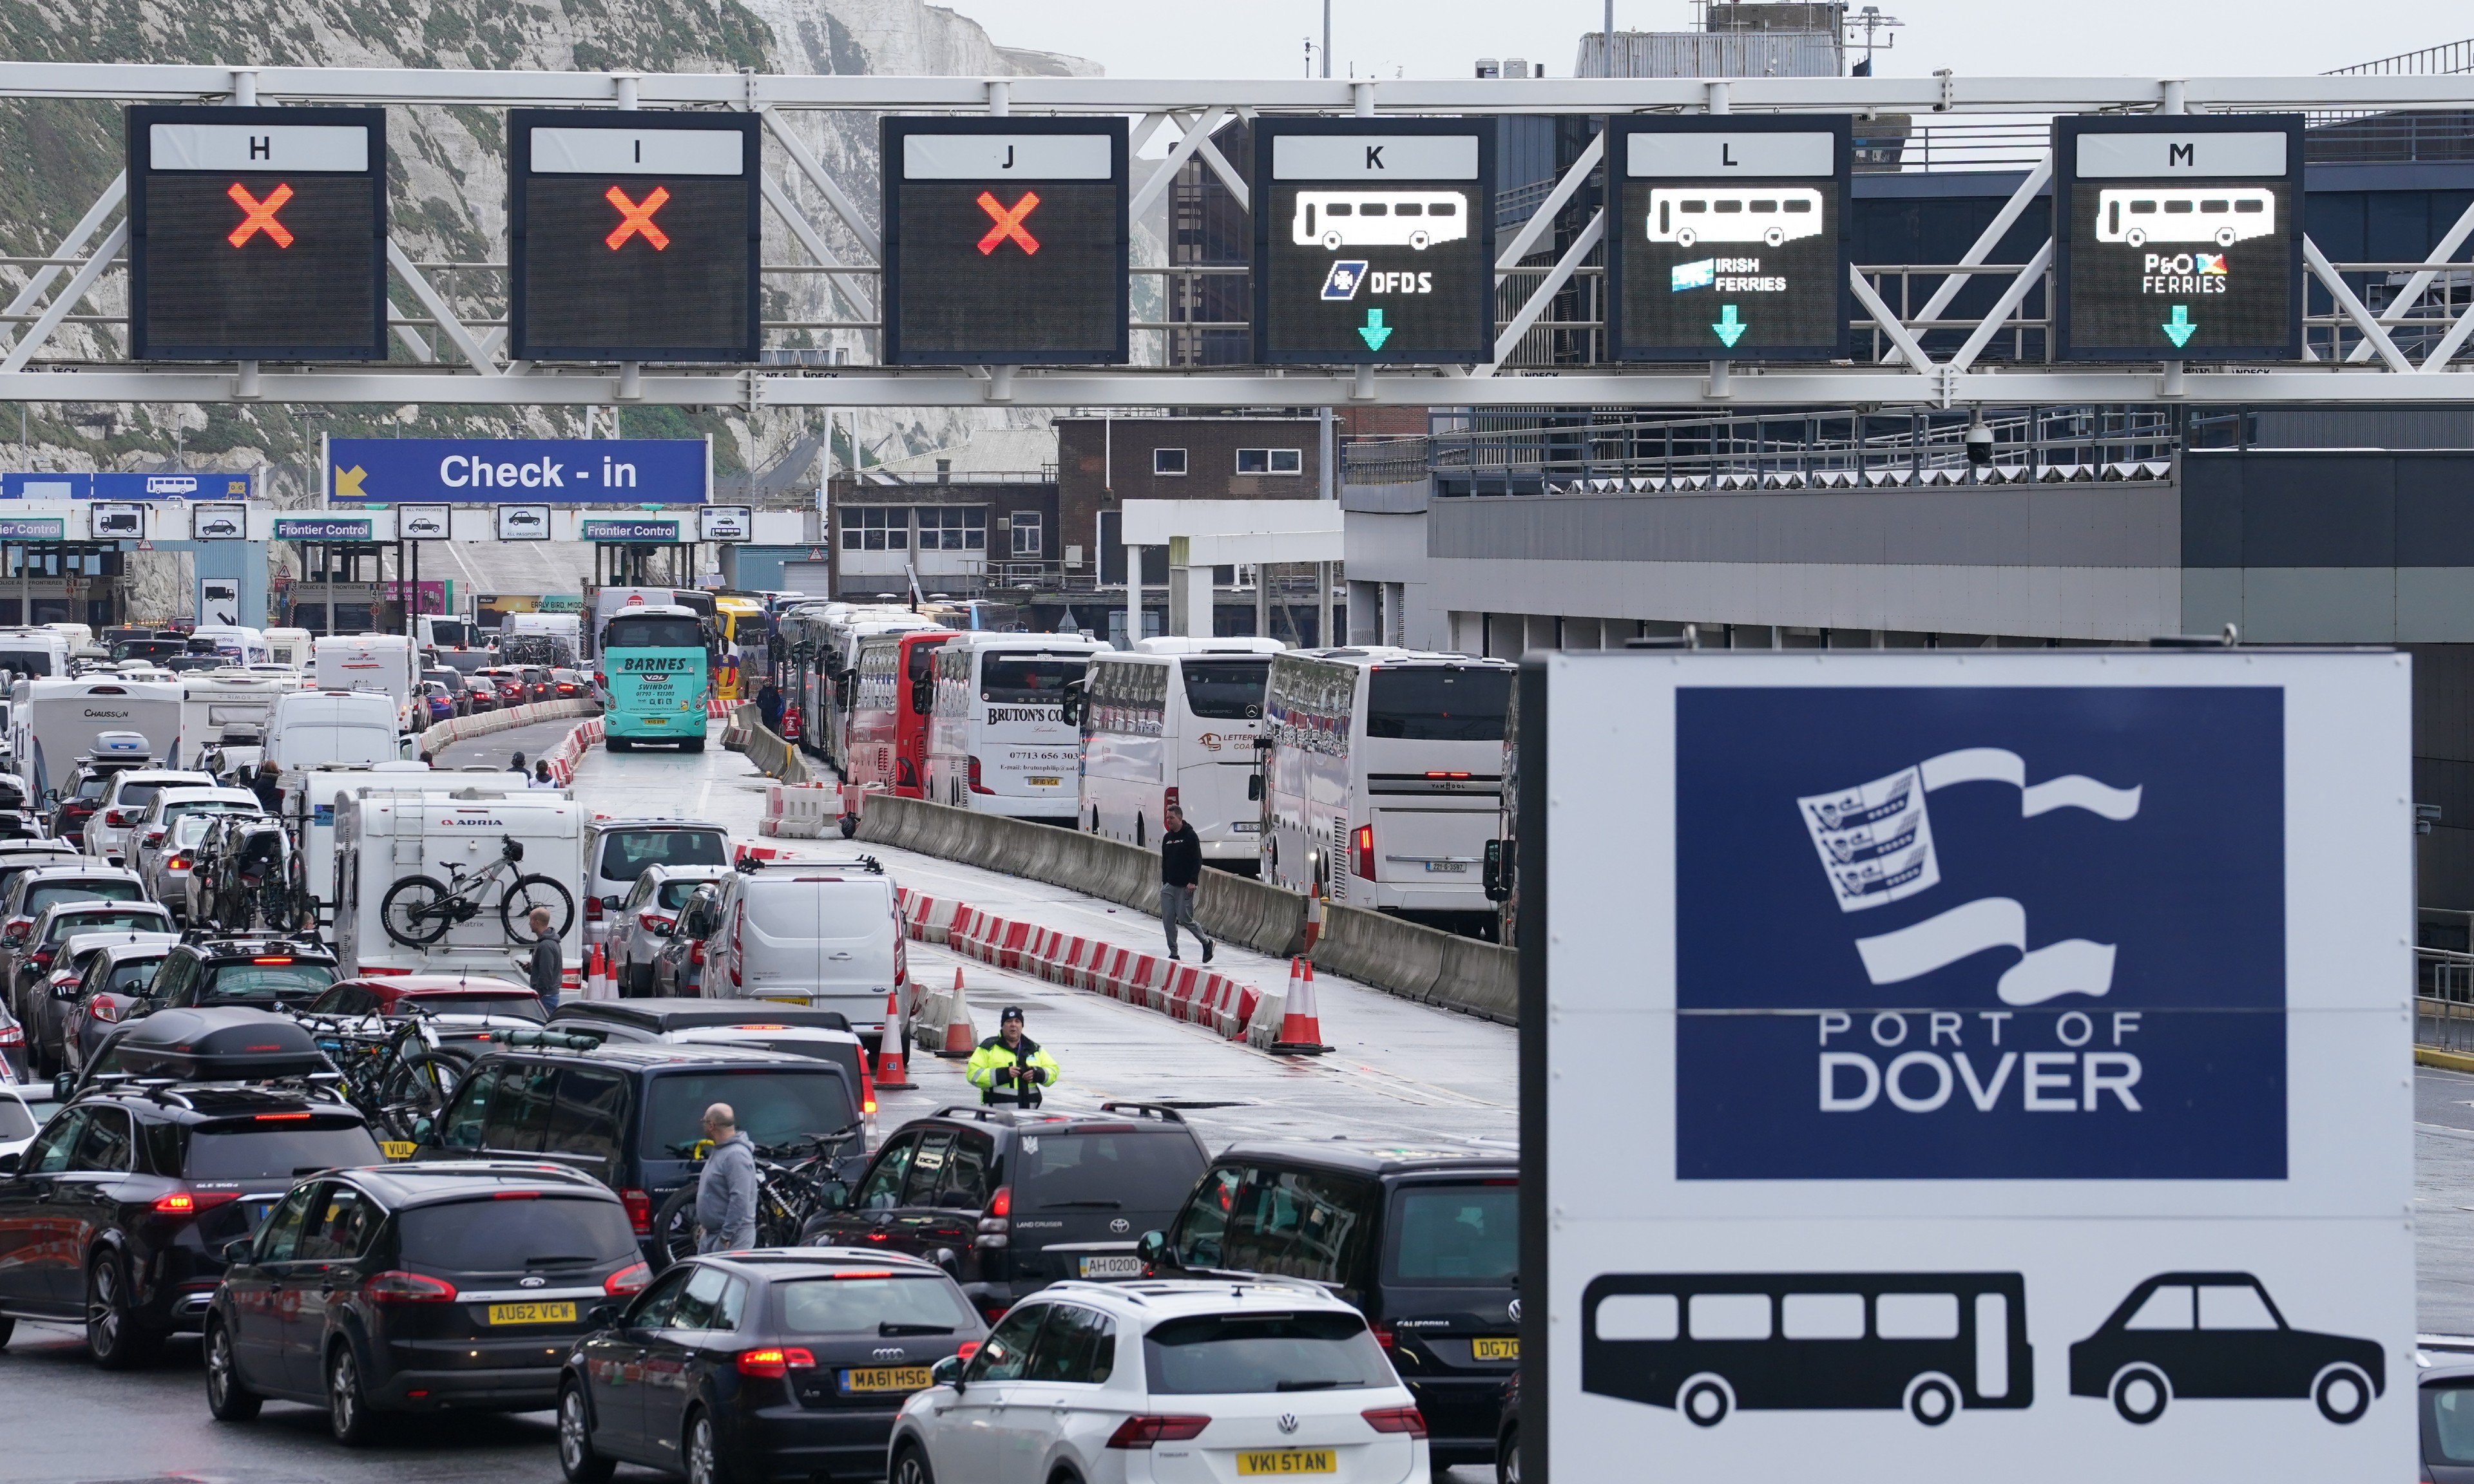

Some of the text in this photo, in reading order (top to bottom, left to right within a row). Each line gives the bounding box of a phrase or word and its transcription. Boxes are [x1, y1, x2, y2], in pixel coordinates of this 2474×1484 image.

[250, 137, 270, 160] H
[634, 140, 640, 164] I
[1001, 146, 1013, 169] J
[1366, 146, 1385, 169] K
[1723, 143, 1738, 166] L
[2169, 144, 2193, 166] M
[1716, 258, 1760, 272] IRISH
[2145, 254, 2193, 274] P&O
[1371, 272, 1432, 293] DFDS
[1715, 277, 1786, 291] FERRIES
[2143, 276, 2226, 294] FERRIES
[440, 455, 564, 488] Check
[604, 456, 637, 487] in
[17, 524, 59, 534] Control
[279, 524, 368, 535] Frontier Control
[588, 526, 675, 536] Frontier Control
[624, 658, 686, 671] BARNES
[84, 709, 128, 718] CHAUSSON
[988, 708, 1044, 725] BRUTON'S
[1819, 1011, 2142, 1047] PORT OF
[1819, 1051, 2143, 1113] DOVER
[1089, 1260, 1106, 1271] AH
[1109, 1259, 1137, 1271] 0200
[497, 1304, 569, 1320] AU62 VCW
[855, 1369, 926, 1387] MA61 HSG
